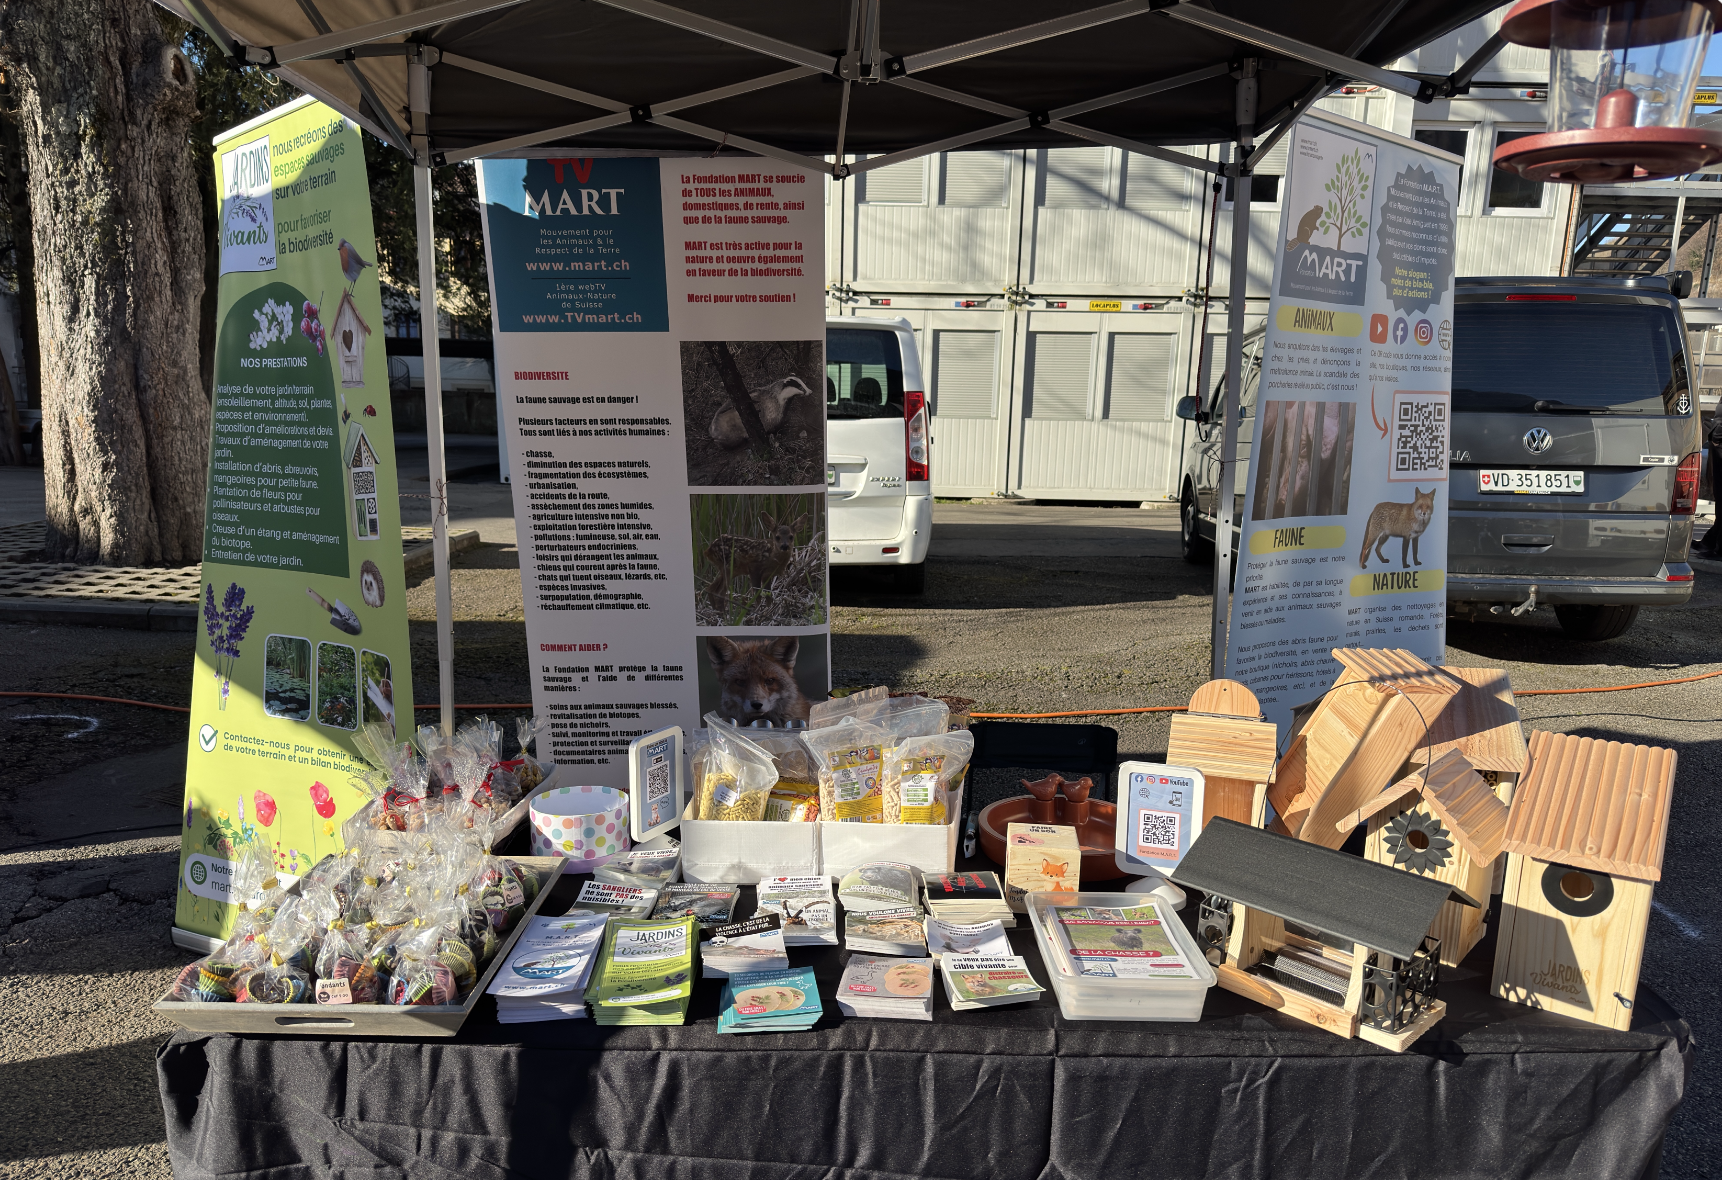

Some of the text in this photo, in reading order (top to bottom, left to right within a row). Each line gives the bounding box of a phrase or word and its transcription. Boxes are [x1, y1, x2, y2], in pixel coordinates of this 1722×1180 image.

[272, 119, 344, 158] nous recréons des
[274, 142, 346, 179] espaces sauvages
[546, 158, 594, 184] TV
[275, 168, 338, 201] sur votre terrain
[681, 173, 805, 184] La Fondation MART se soucie
[682, 187, 774, 198] de TOUS les ANIMAUX,
[524, 188, 624, 216] MART
[682, 200, 804, 211] domestiques, de rente, ainsi
[278, 208, 332, 235] pour favoriser
[683, 214, 790, 225] que de la faune sauvage.
[278, 228, 334, 256] la biodiversité
[525, 260, 629, 271] www.mart.ch
[1296, 249, 1363, 283] MART
[1395, 266, 1428, 281] Notre slogan
[556, 283, 574, 291] 1ère
[1404, 279, 1412, 288] de
[687, 293, 796, 303] Merci pour votre soutien !
[522, 312, 641, 323] www.TVmart.ch
[240, 357, 308, 368] NOS PRESTATIONS
[514, 371, 570, 381] BIODIVERSITE
[516, 395, 526, 403] La
[525, 396, 547, 404] faune
[582, 396, 595, 404] est
[607, 395, 634, 404] danger
[518, 417, 554, 426] Plusieurs
[555, 418, 587, 426] facteurs
[618, 417, 671, 426] responsables.
[212, 536, 253, 550] du biotope.
[1274, 527, 1306, 548] FAUNE
[211, 549, 303, 566] Entretien de votre jardin.
[1373, 571, 1419, 592] NATURE
[540, 643, 608, 652] COMMENT AIDER ?
[223, 732, 364, 764] Contactez-nous pour obtenir une
[223, 743, 332, 769] de votre terrain et un bilan
[1170, 778, 1189, 786] YouTube
[211, 862, 233, 876] Notre
[602, 884, 643, 895] SANGLIERS
[582, 896, 620, 904] nuisibles
[630, 928, 683, 944] JARDINS
[618, 946, 676, 956] Vivants
[1541, 960, 1591, 986] JARDINS
